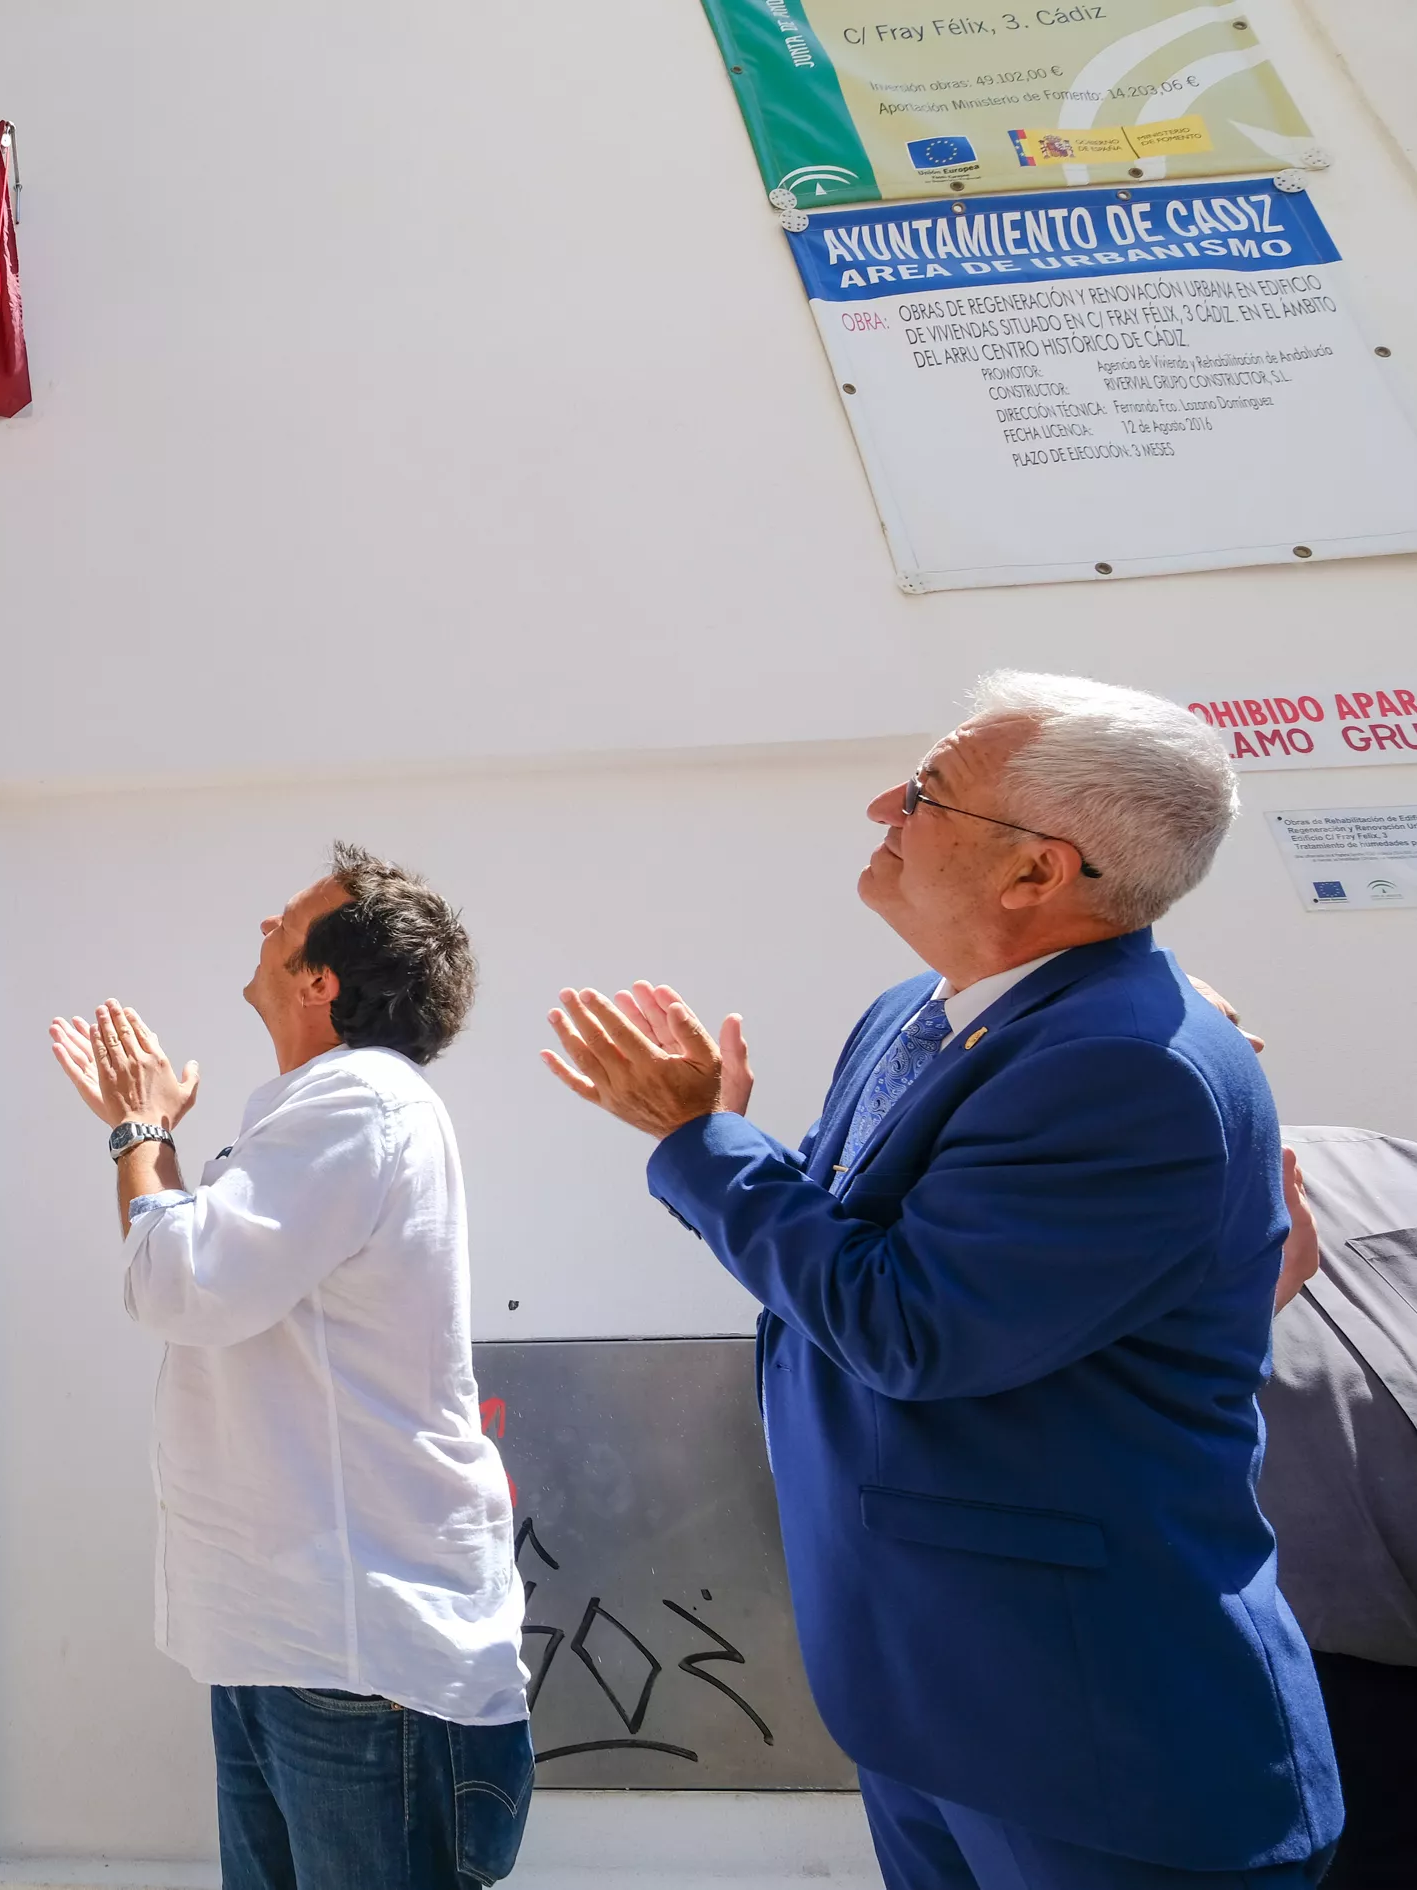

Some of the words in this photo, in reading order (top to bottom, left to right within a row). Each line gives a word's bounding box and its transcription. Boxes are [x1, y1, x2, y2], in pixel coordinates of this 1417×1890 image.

[777, 20, 798, 32] DE
[843, 26, 866, 45] C/
[875, 23, 924, 43] Fray
[932, 18, 996, 37] Félix,
[1001, 13, 1029, 31] 3.
[1036, 5, 1107, 27] Cádiz
[785, 35, 815, 68] JUNTA
[869, 80, 926, 93] Inversión
[930, 79, 972, 91] obras:
[976, 68, 1048, 86] 49.102,00
[1050, 65, 1064, 78] €
[879, 102, 949, 116] Aportación
[952, 95, 1020, 110] Ministerio
[1023, 90, 1040, 102] de
[1045, 88, 1102, 102] Fomento:
[1108, 79, 1183, 99] 14.203,06
[1186, 75, 1200, 88] €
[1136, 127, 1191, 141] MINISTERIO
[1157, 133, 1202, 144] FOMENTO
[943, 164, 980, 175] Europea
[823, 206, 1098, 265] AYUNTAMIENTO
[1106, 202, 1165, 247] DE
[1166, 194, 1285, 238] CADIZ
[840, 263, 952, 289] AREA
[960, 259, 1022, 275] DE
[1030, 239, 1292, 269] URBANISMO
[898, 301, 944, 322] OBRAS
[945, 298, 967, 316] DE
[967, 286, 1075, 314] REGENERACIÓN
[1074, 289, 1084, 305] Y
[1088, 278, 1183, 302] RENOVACIÓN
[1184, 280, 1234, 299] URBANA
[1235, 281, 1257, 298] EN
[1258, 274, 1322, 296] EDIFICIO
[841, 312, 890, 332] OBRA:
[905, 327, 925, 345] DE
[928, 320, 999, 343] VIVIENDAS
[1003, 314, 1062, 336] SITUADO
[1063, 313, 1086, 330] EN
[1086, 311, 1104, 330] C/
[1107, 310, 1140, 327] FRAY
[1142, 302, 1183, 325] FÉLIX,
[1183, 304, 1193, 322] 3
[1195, 300, 1239, 324] CÁDIZ.
[1239, 304, 1263, 322] EN
[1264, 301, 1281, 320] EL
[1281, 295, 1337, 319] ÁMBITO
[913, 350, 943, 369] DEL
[945, 346, 979, 366] ARRU
[981, 340, 1041, 361] CENTRO
[1041, 331, 1119, 357] HISTÓRICO
[1121, 332, 1143, 349] DE
[1144, 326, 1189, 348] CÁDIZ.
[1097, 358, 1137, 374] Agencia
[1138, 357, 1151, 369] de
[1153, 355, 1189, 370] Vivienda
[1190, 359, 1197, 373] y
[1197, 351, 1265, 368] Rehabilitación
[1265, 351, 1278, 364] de
[1279, 344, 1334, 364] Andalucía
[981, 365, 1044, 381] PROMOTOR:
[1103, 375, 1153, 391] RIVERVIAL
[1154, 373, 1188, 390] GRUPO
[1189, 370, 1272, 389] CONSTRUCTOR,
[1271, 369, 1292, 384] S.L.
[988, 382, 1070, 401] CONSTRUCTOR:
[996, 403, 1057, 423] DIRECCIÓN
[1057, 401, 1108, 419] TÉCNICA:
[1113, 399, 1159, 415] Fernando
[1161, 398, 1181, 413] Fco.
[1182, 398, 1217, 412] Lozano
[1217, 394, 1274, 412] Domínguez
[1003, 426, 1042, 444] FECHA
[1043, 422, 1093, 440] LICENCIA:
[1121, 420, 1136, 436] 12
[1138, 420, 1151, 433] de
[1153, 419, 1186, 435] Agosto
[1186, 416, 1213, 432] 2016
[1012, 450, 1049, 467] PLAZO
[1050, 447, 1067, 463] DE
[1068, 441, 1131, 461] EJECUCIÓN:
[1132, 444, 1142, 457] 3
[1142, 442, 1175, 457] MESES
[1230, 728, 1314, 759] AMO
[1291, 834, 1323, 842] Edificio
[1336, 833, 1355, 841] Fray
[1294, 842, 1345, 850] Tratamiento
[1359, 840, 1410, 848] humedades
